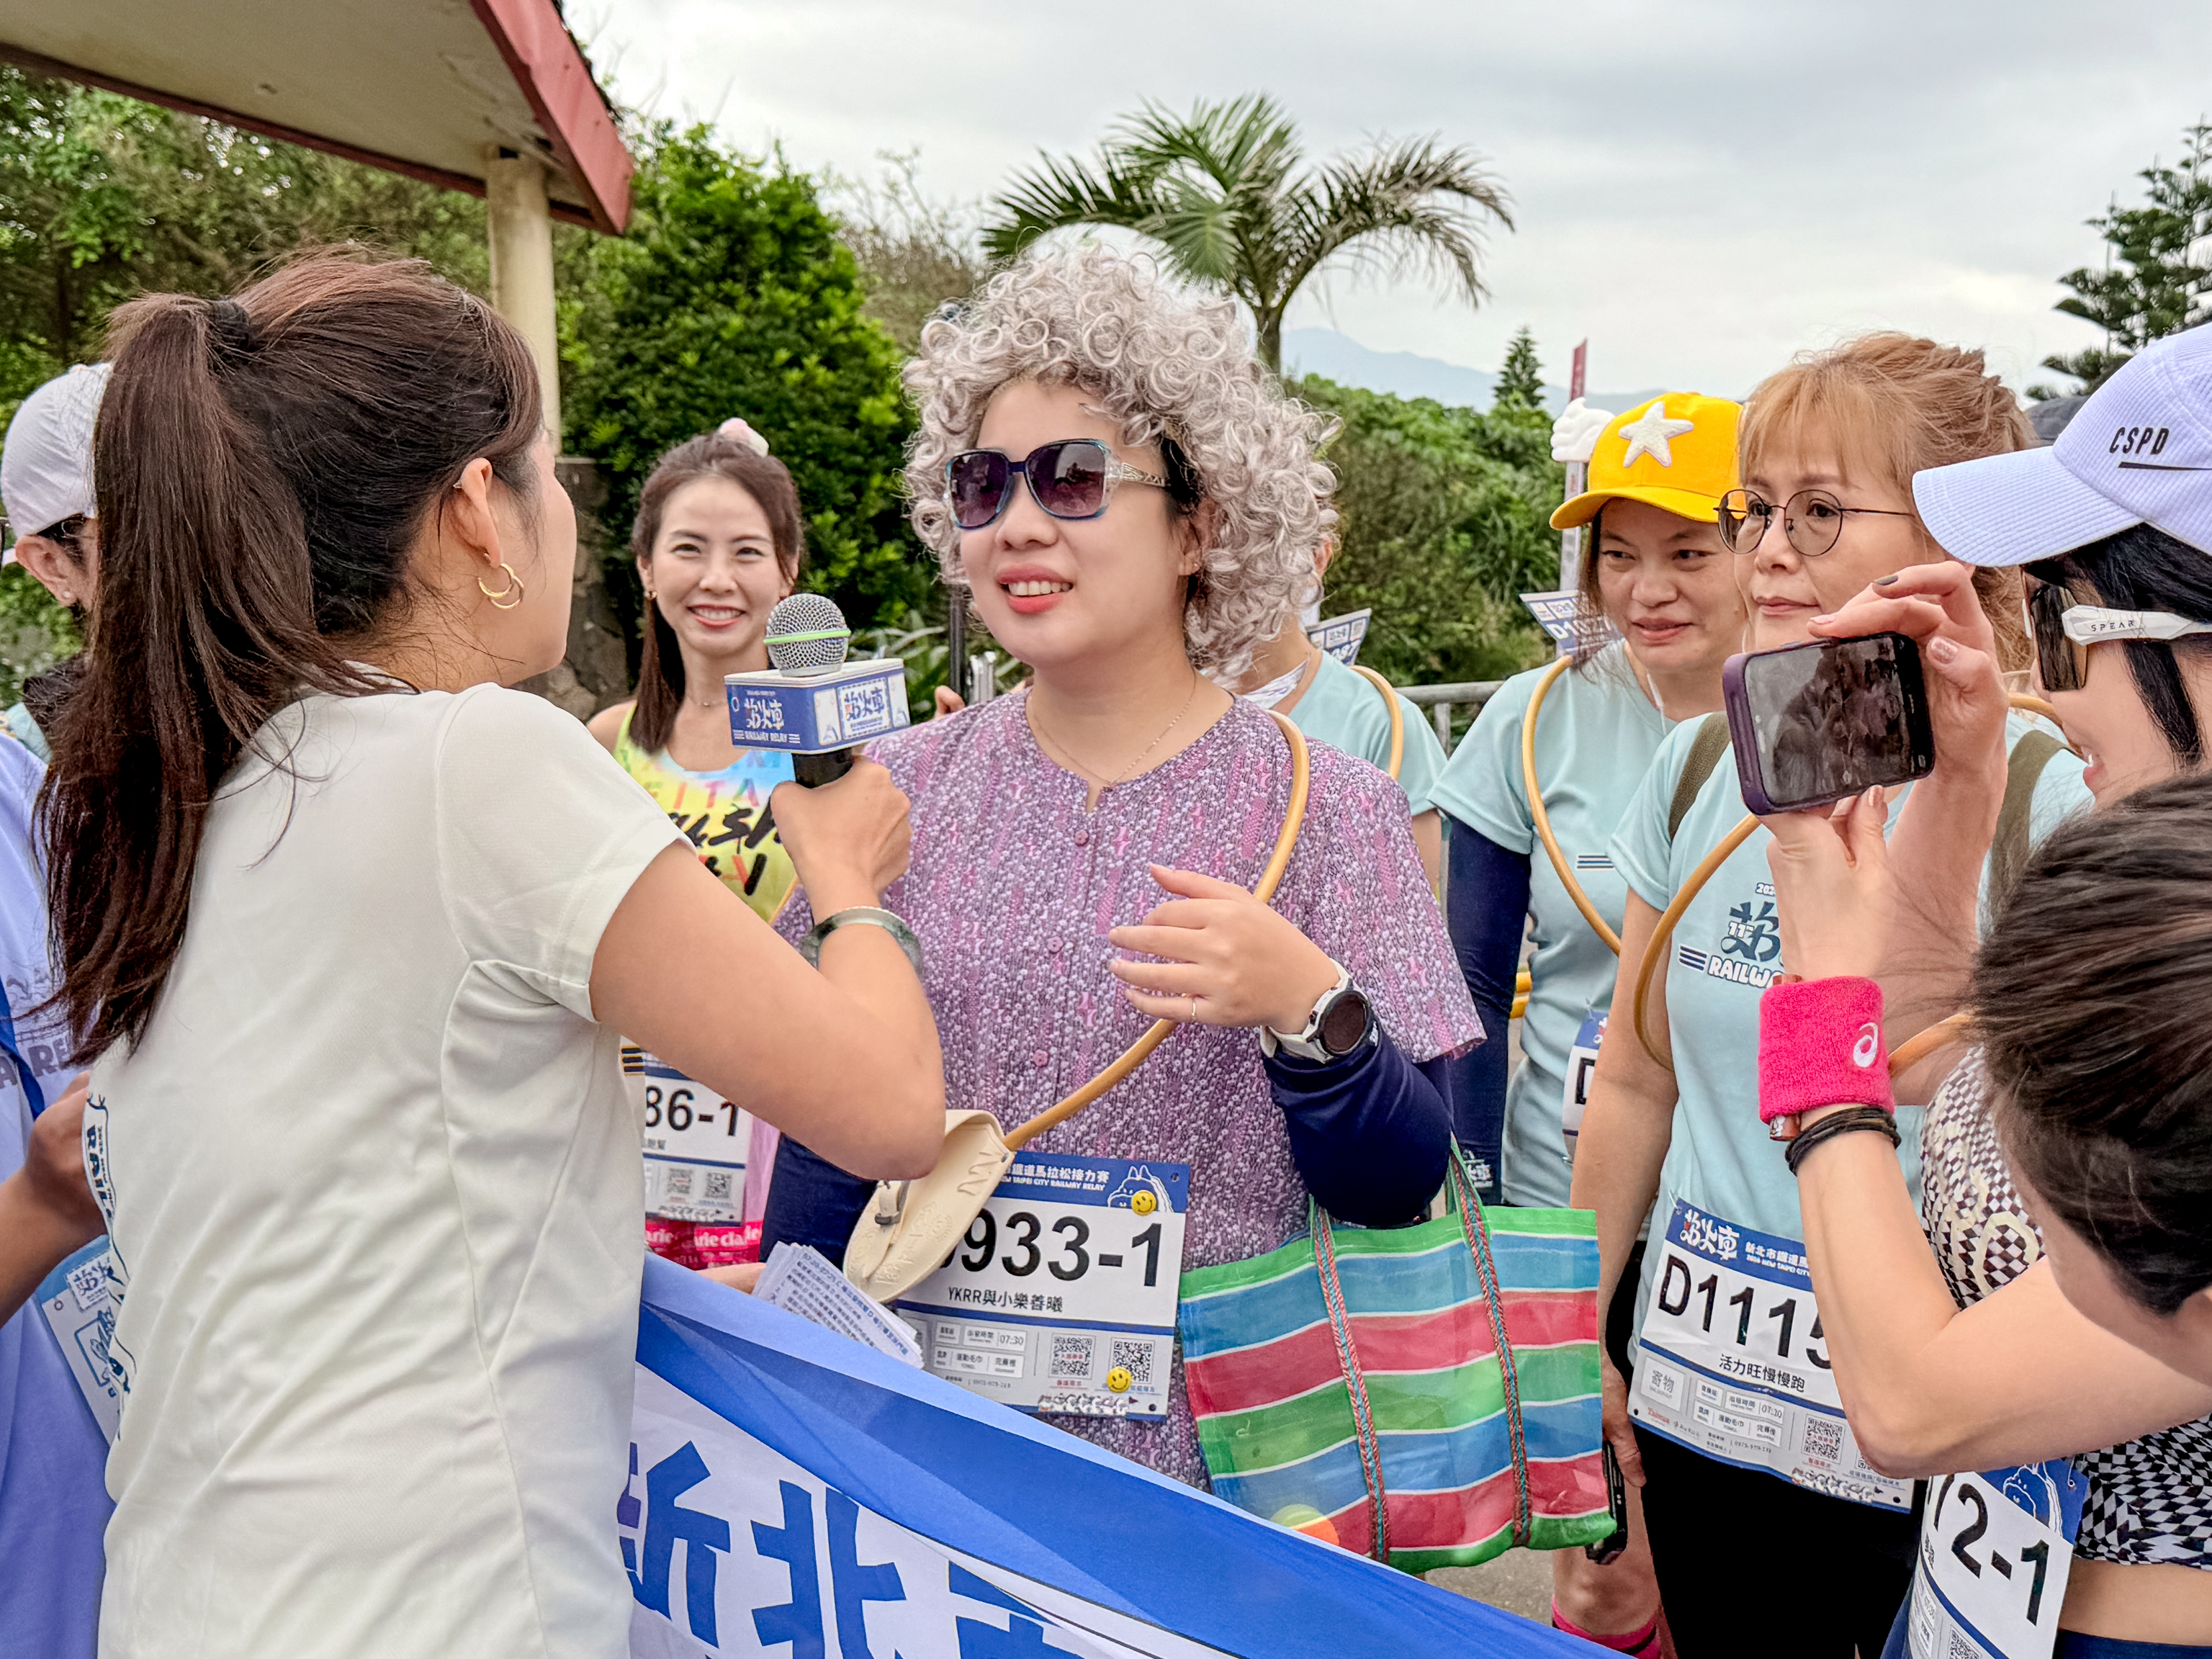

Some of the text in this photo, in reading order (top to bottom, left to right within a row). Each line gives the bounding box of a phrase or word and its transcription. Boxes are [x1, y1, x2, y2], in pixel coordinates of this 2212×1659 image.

[2109, 426, 2170, 455] CSPD
[2090, 619, 2135, 631] SPEAR
[1007, 1163, 1111, 1184] 鐵道馬拉松接力賽
[1013, 1176, 1033, 1185] TAIPEI
[1033, 1178, 1050, 1187] CITY
[1050, 1179, 1082, 1190] RAILWAY
[1082, 1182, 1106, 1192] RELAY
[940, 1208, 1162, 1288] 933-1
[1658, 1253, 1832, 1370] D1115
[999, 1334, 1024, 1346] 07:30
[1650, 1370, 1675, 1394] 寄物
[1719, 1353, 1806, 1393] 活力旺慢慢跑
